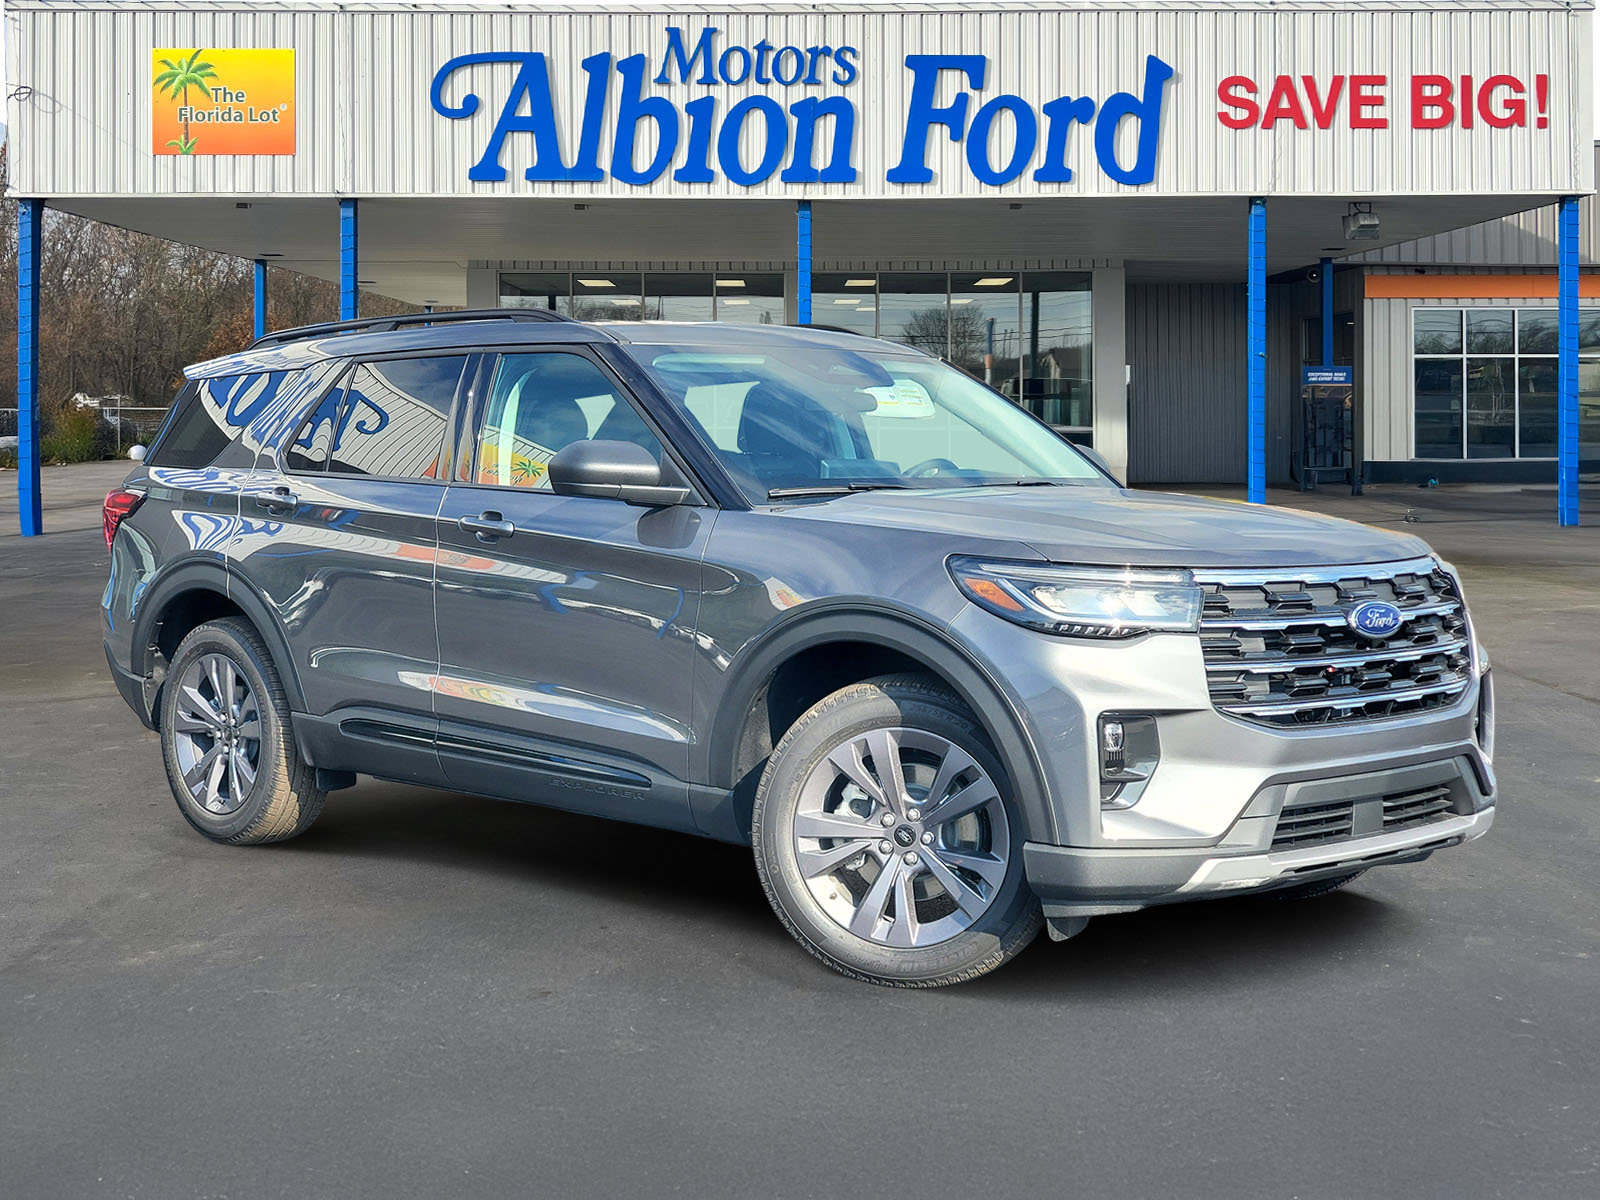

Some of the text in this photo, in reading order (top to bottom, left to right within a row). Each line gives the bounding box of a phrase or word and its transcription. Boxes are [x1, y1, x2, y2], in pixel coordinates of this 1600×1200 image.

[652, 26, 858, 87] Motors
[210, 86, 247, 103] The
[1217, 74, 1549, 129] SAVE BIG!
[178, 106, 279, 122] Florida Lot
[429, 51, 1174, 186] Albion Ford
[1364, 607, 1395, 628] Ford
[550, 779, 646, 801] EXPLORER
